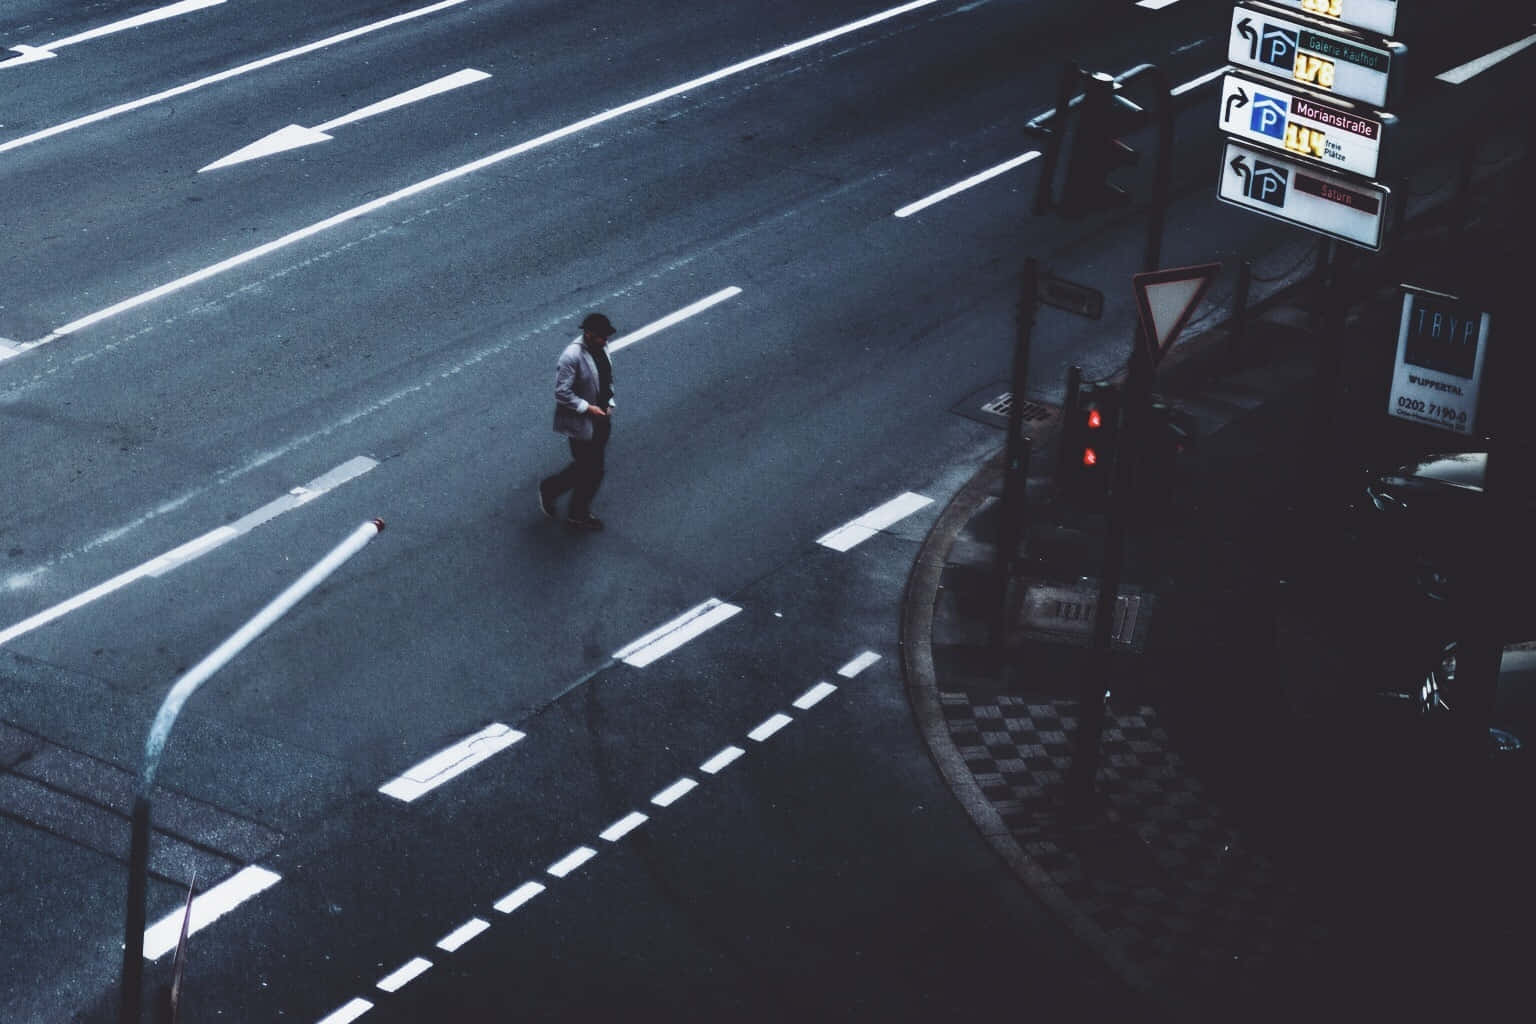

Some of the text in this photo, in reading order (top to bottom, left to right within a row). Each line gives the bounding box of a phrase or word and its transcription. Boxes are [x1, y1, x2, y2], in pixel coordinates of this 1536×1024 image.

[1309, 36, 1341, 56] Galerie
[1344, 48, 1378, 67] Kaufhof
[1297, 102, 1372, 136] Morianstraße
[1324, 148, 1346, 162] Plätze
[1325, 140, 1342, 151] freie
[1320, 183, 1352, 205] Saturn
[1417, 308, 1475, 344] TRYP
[1409, 374, 1464, 396] WUPPERTAL
[1398, 396, 1426, 413] 0202
